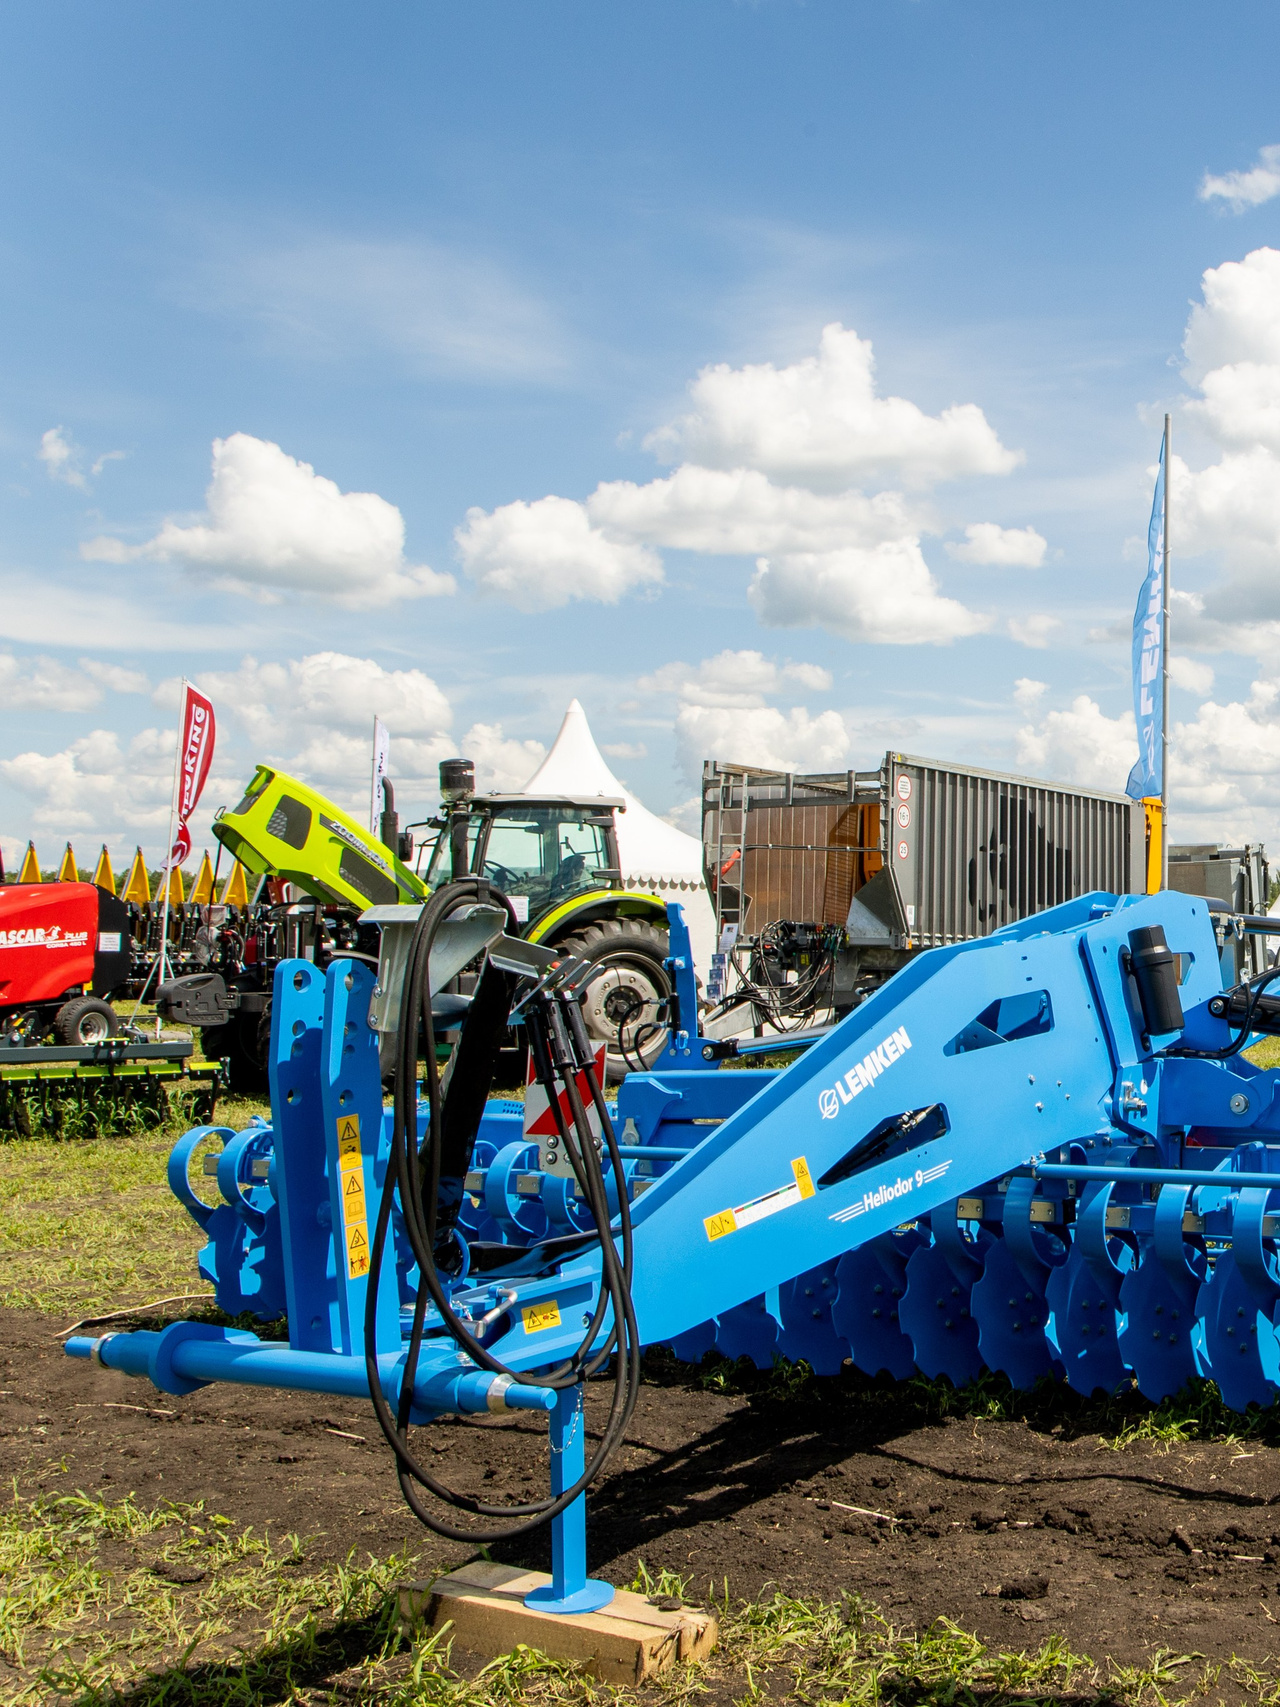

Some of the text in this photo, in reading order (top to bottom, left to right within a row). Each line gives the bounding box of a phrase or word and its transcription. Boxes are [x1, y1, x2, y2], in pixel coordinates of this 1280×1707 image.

[834, 1025, 913, 1106] LEMKEN
[863, 1169, 924, 1212] Heliodor 9
